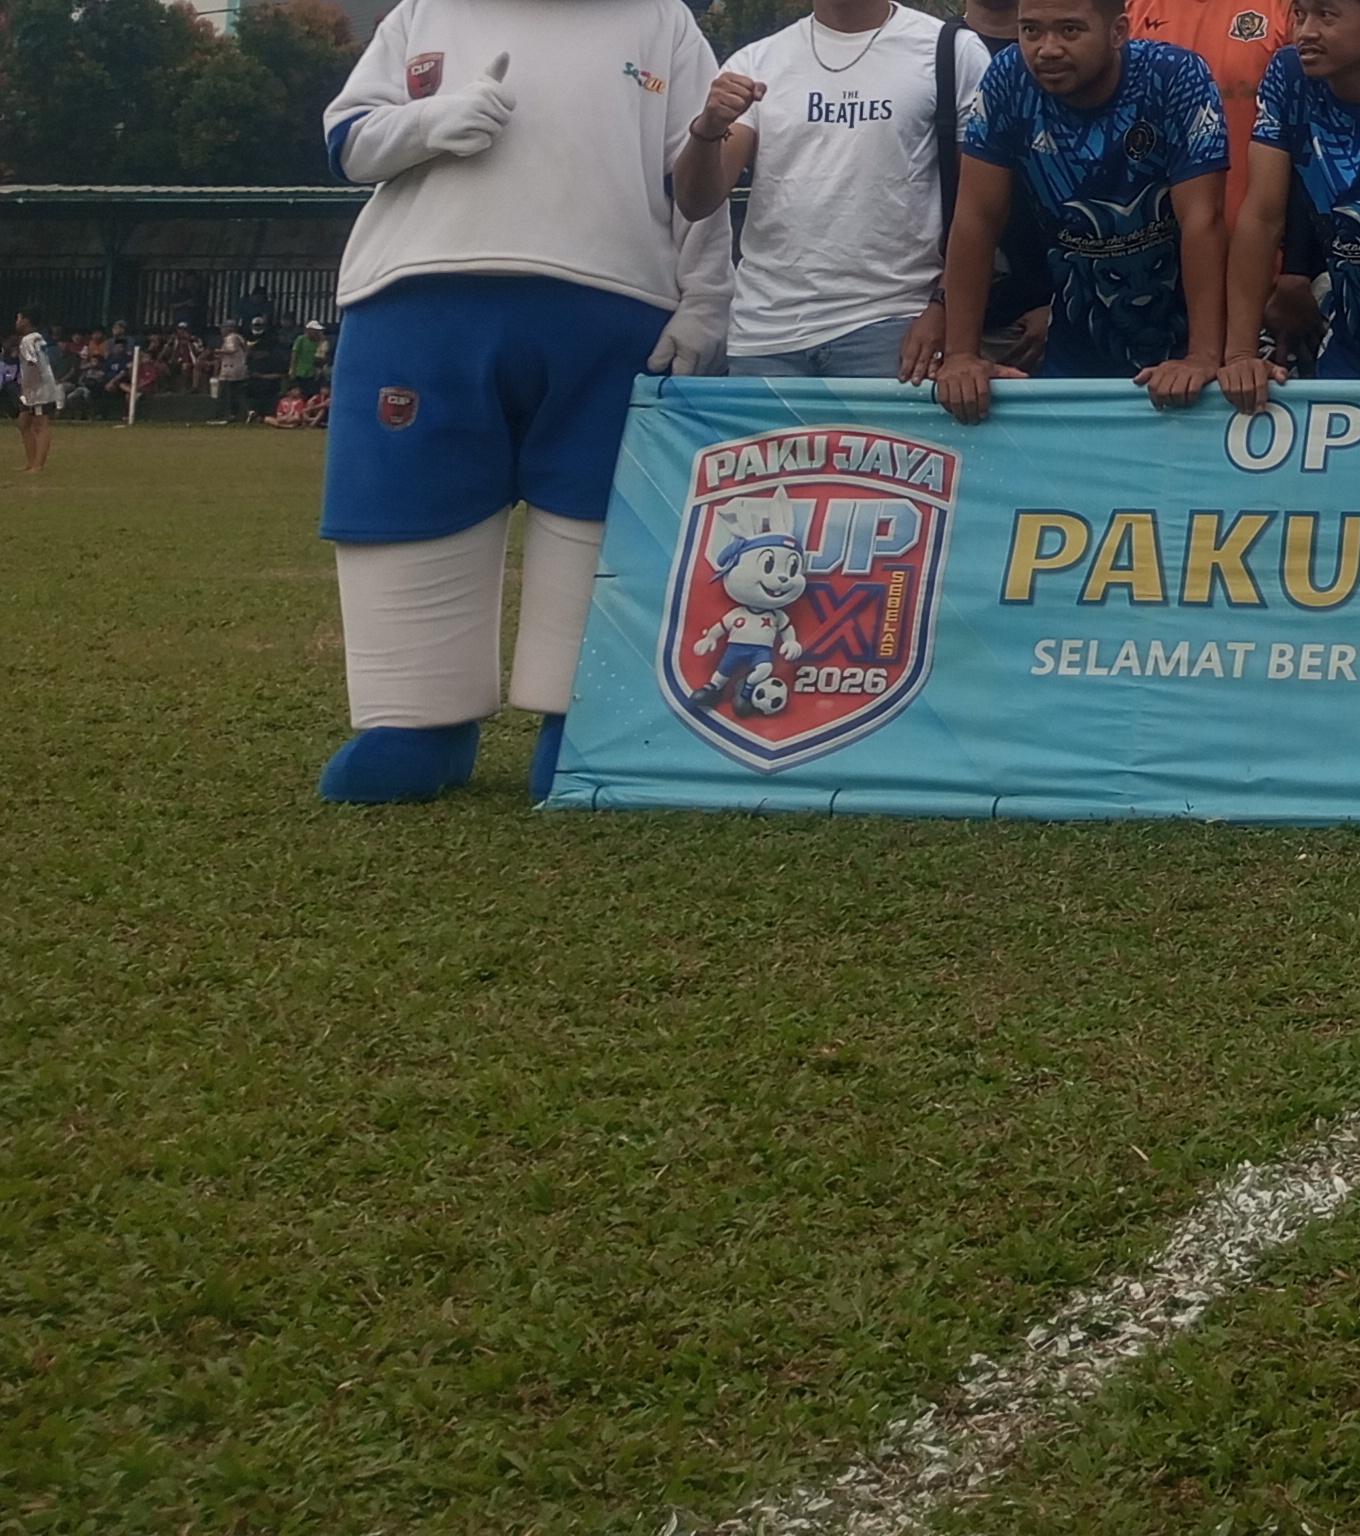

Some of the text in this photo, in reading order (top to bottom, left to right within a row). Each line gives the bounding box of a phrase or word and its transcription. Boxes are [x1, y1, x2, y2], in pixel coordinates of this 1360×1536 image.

[807, 91, 893, 129] BEATLES
[841, 90, 860, 99] THE
[706, 436, 945, 493] PAKU JAYA
[879, 571, 905, 657] SEBELAS
[1030, 638, 1256, 678] SELAMAT
[794, 666, 888, 694] 2026
